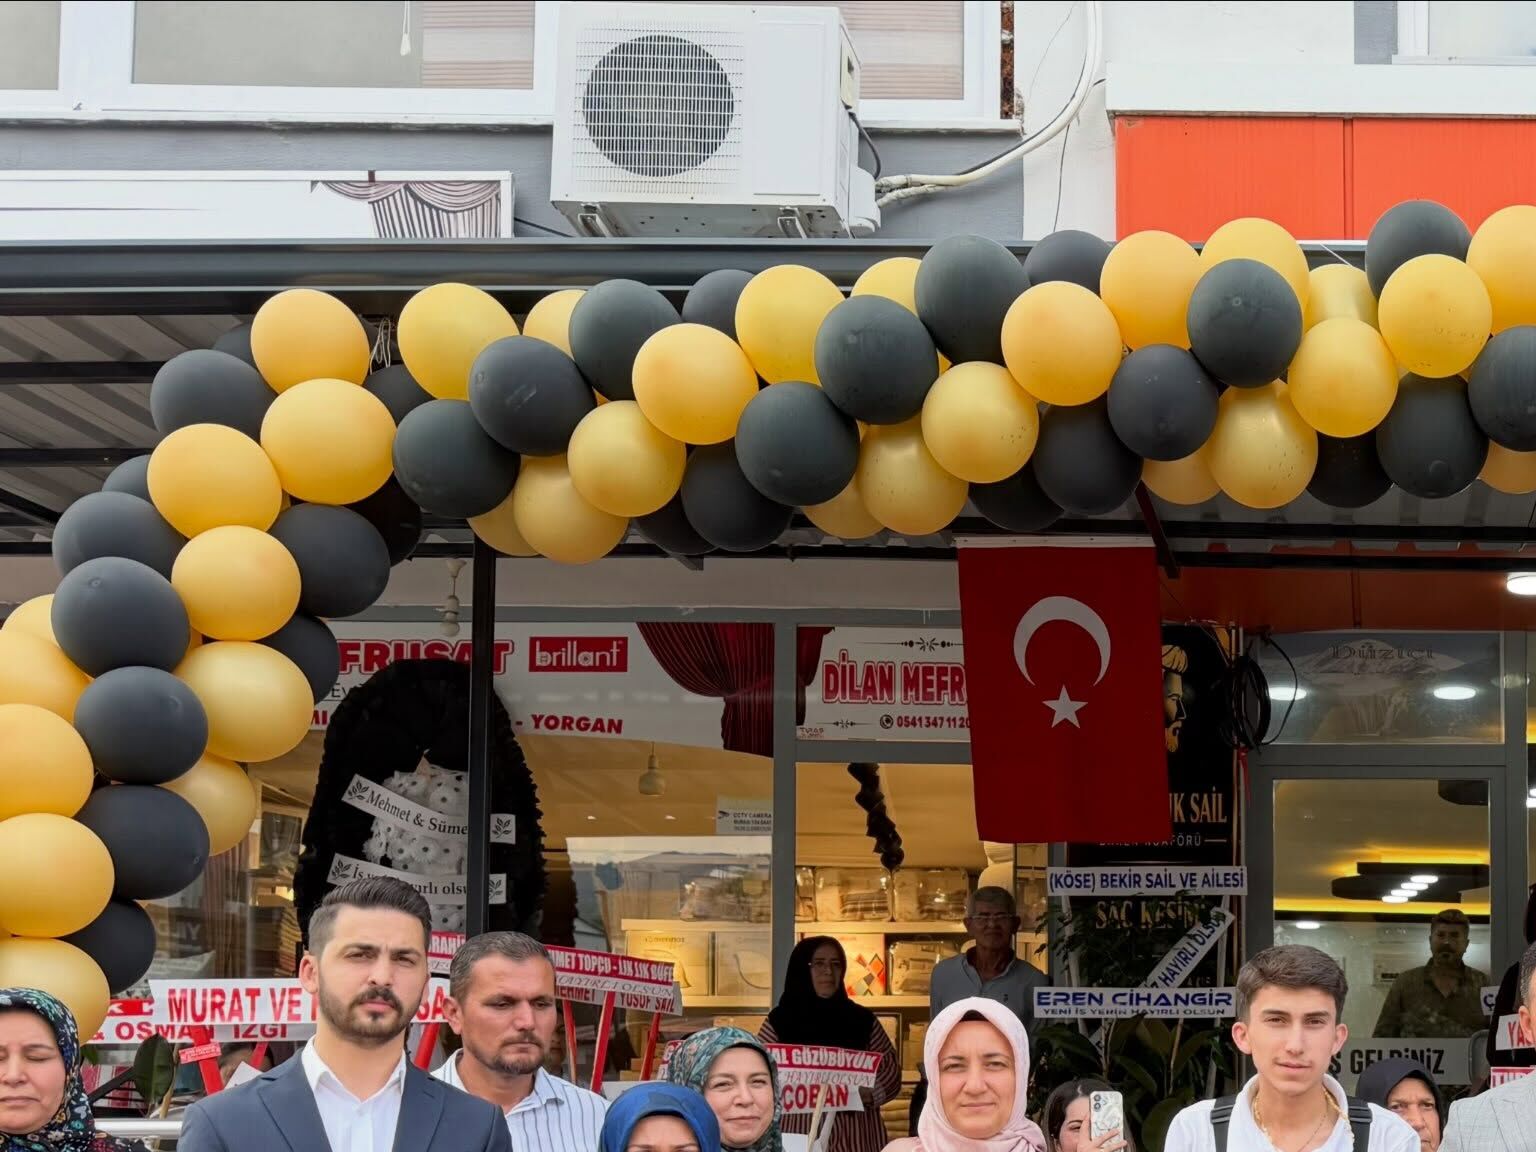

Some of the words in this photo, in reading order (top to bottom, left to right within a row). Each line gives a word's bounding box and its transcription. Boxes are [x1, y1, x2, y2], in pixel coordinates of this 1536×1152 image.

[535, 640, 620, 667] brillant
[823, 649, 895, 705] DİLAN
[901, 662, 968, 706] MEFR
[531, 713, 623, 735] YORGAN
[365, 789, 412, 824] Mehmet
[413, 812, 424, 828] &
[428, 816, 468, 836] Süme
[1190, 785, 1227, 823] SAİL
[1050, 869, 1096, 892] (KÖSE)
[1100, 868, 1142, 889] BEKİR
[1145, 868, 1177, 889] SAİL
[1180, 872, 1198, 888] VE
[1202, 867, 1244, 888] AİLESİ
[578, 952, 612, 974] TOPÇU
[1158, 944, 1198, 988] HAYIRLI
[168, 986, 261, 1023] MURAT
[269, 986, 304, 1022] VE
[1037, 991, 1103, 1007] EREN
[1111, 988, 1233, 1007] CİHANGİR
